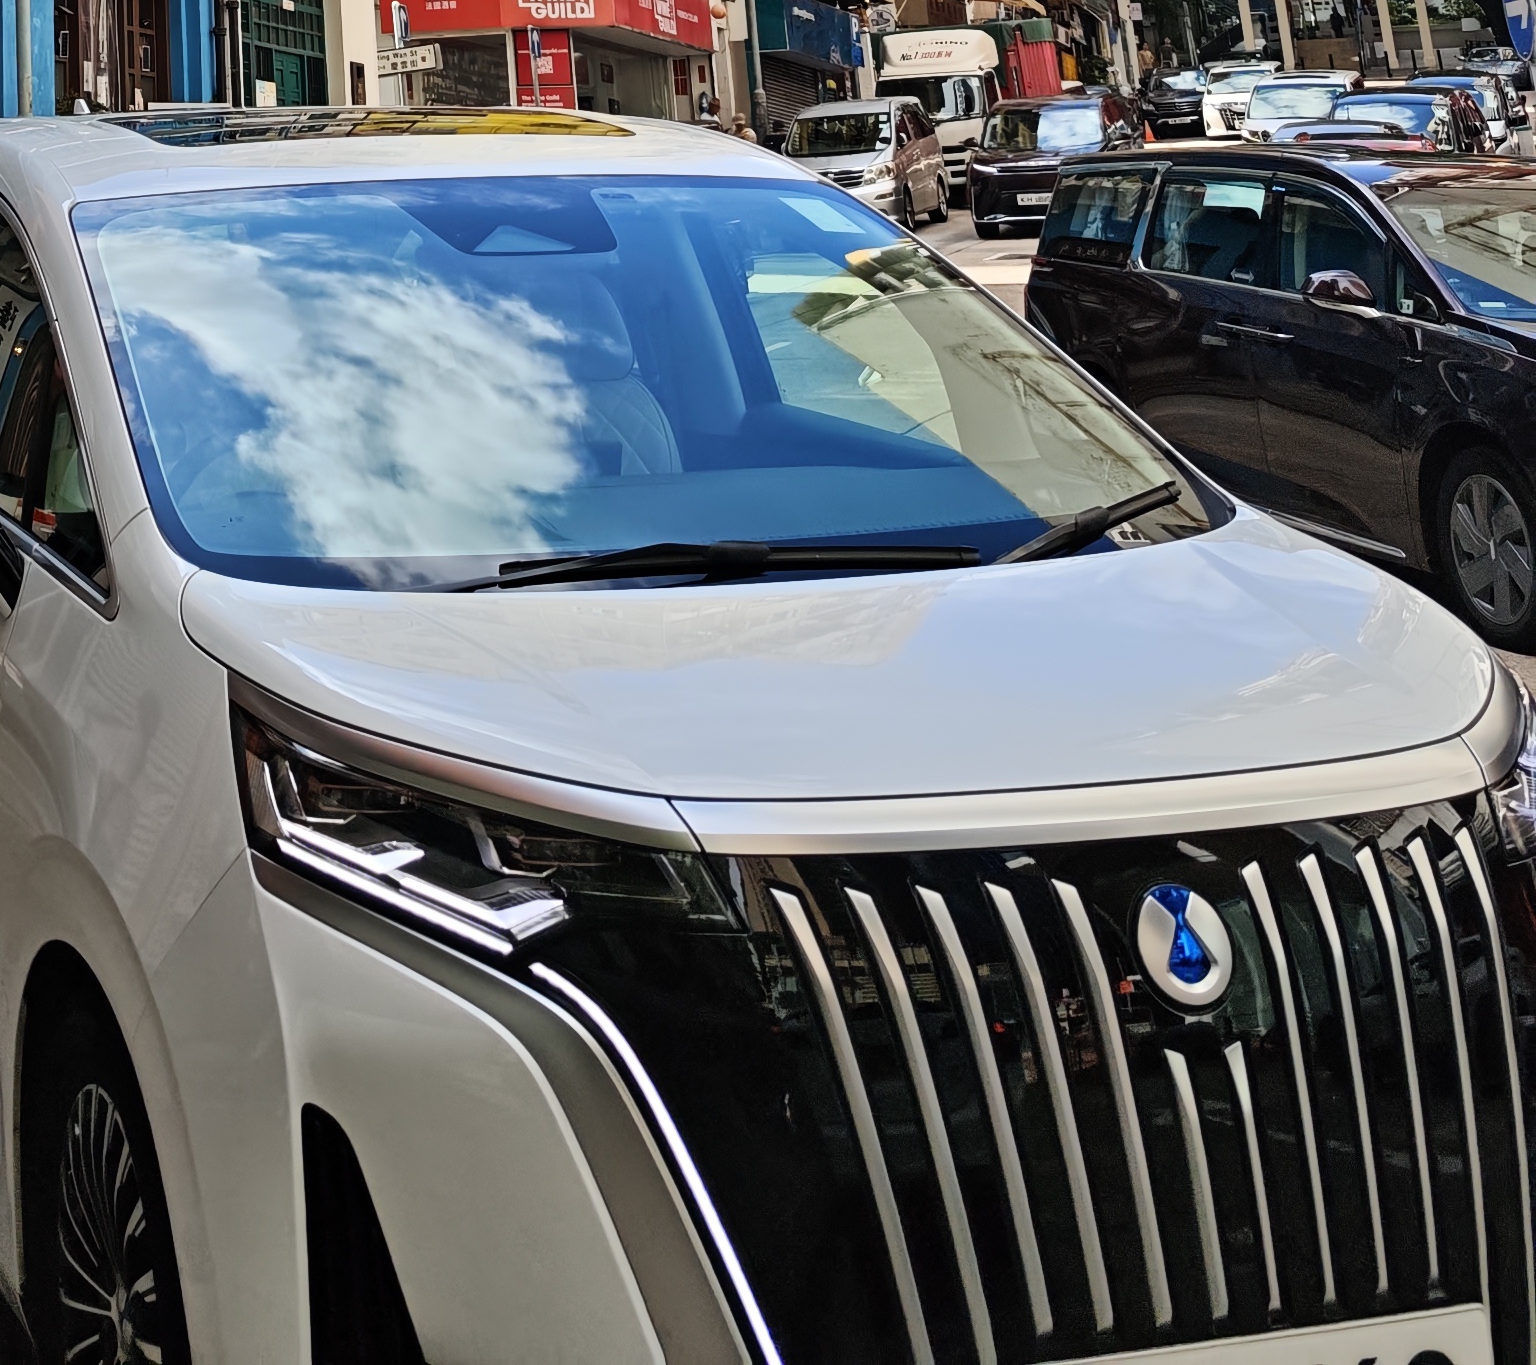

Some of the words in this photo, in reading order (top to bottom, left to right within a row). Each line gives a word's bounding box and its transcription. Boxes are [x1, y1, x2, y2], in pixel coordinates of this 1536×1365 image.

[531, 2, 590, 19] GUILD
[392, 51, 408, 59] Wan
[410, 49, 418, 57] St
